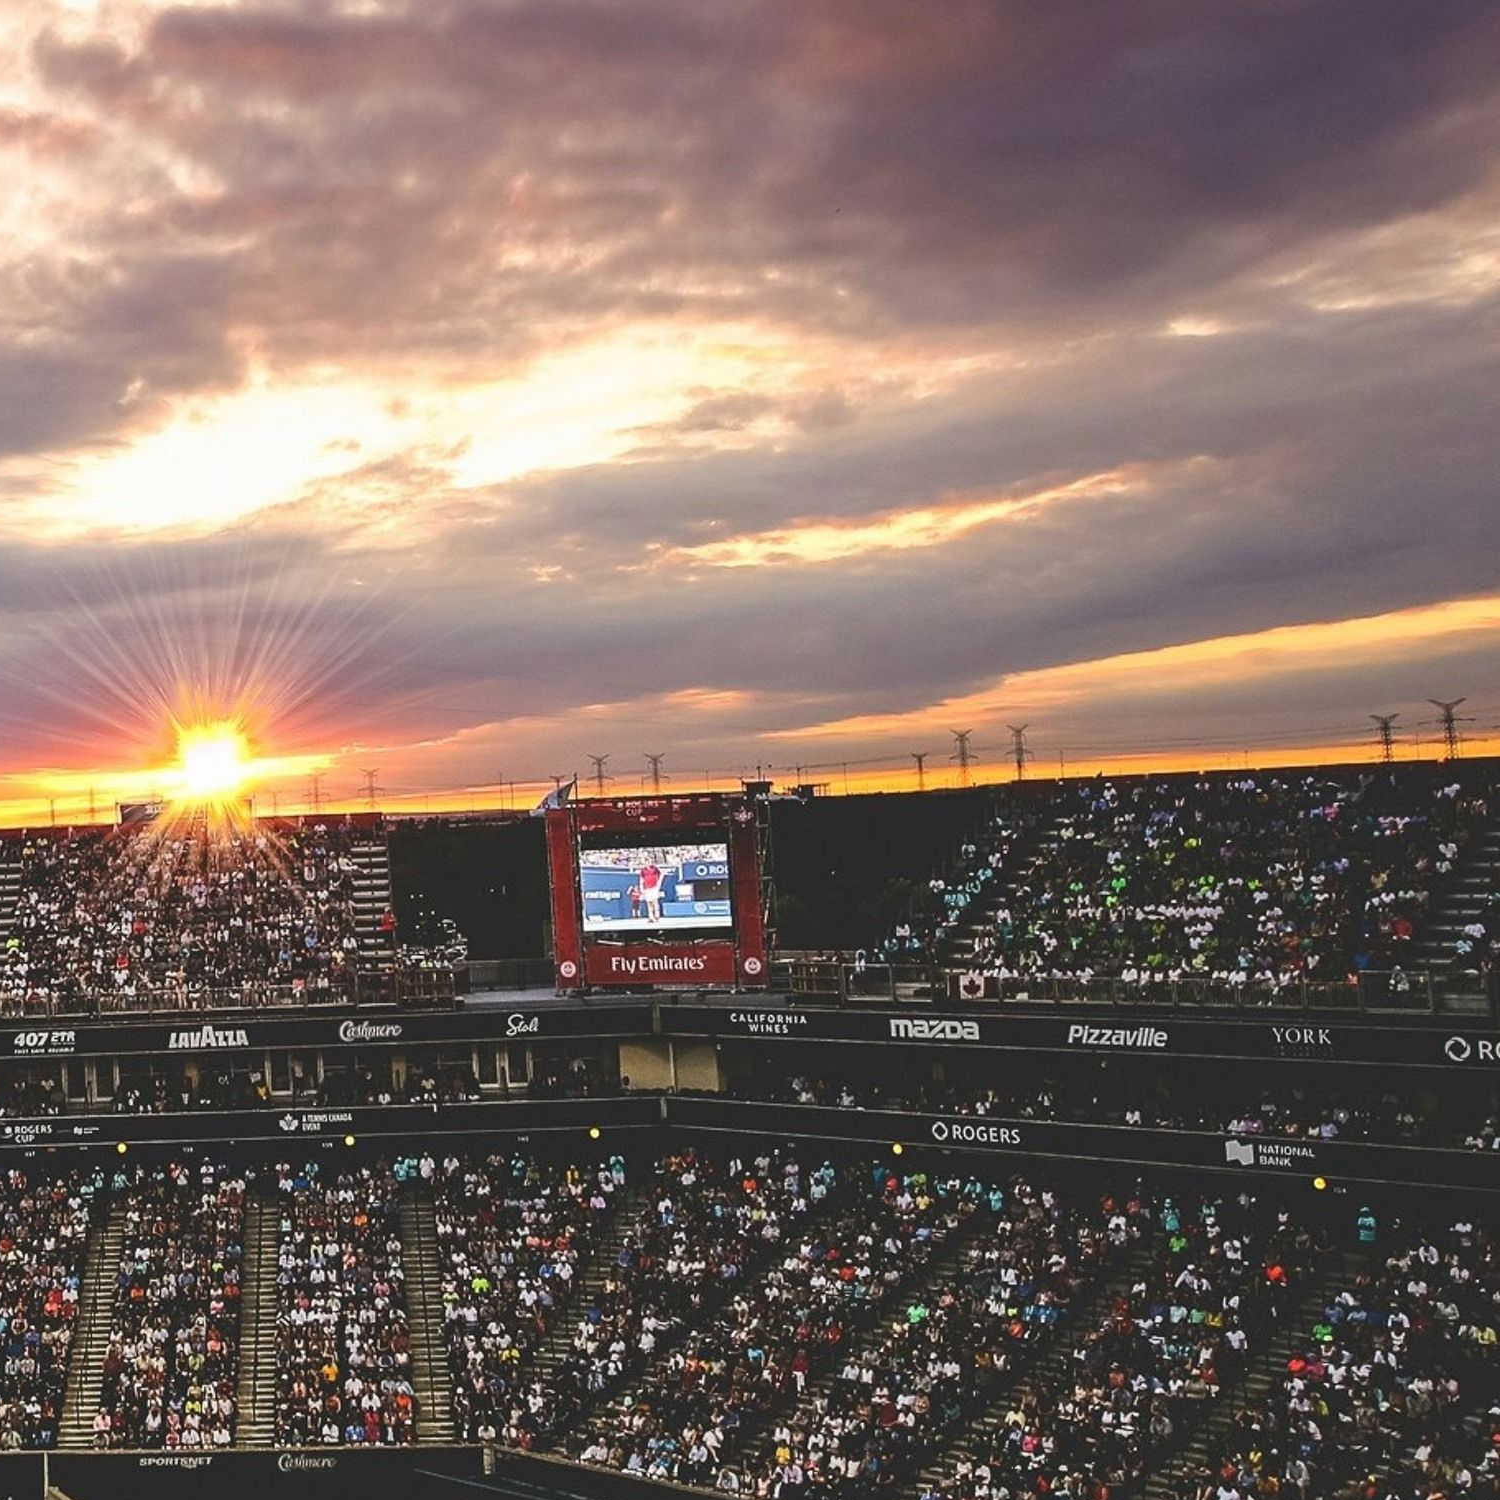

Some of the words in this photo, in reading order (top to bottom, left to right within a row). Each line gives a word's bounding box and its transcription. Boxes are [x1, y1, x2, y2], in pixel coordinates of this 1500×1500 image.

[611, 956, 636, 974] Fly
[638, 955, 705, 971] Emirates
[729, 1012, 807, 1024] CALIFORNIA
[748, 1024, 789, 1034] WINES
[1067, 1024, 1169, 1048] Pizzaville
[1272, 1027, 1332, 1045] YORK
[14, 1032, 49, 1047] 407
[168, 1025, 249, 1049] LAVAZZA
[14, 1124, 52, 1134] ROGERS
[951, 1124, 1021, 1144] ROGERS
[15, 1134, 35, 1143] CUP
[1259, 1144, 1316, 1158] NATIONAL
[1259, 1156, 1292, 1167] BANK
[139, 1456, 213, 1469] SPORTSNET
